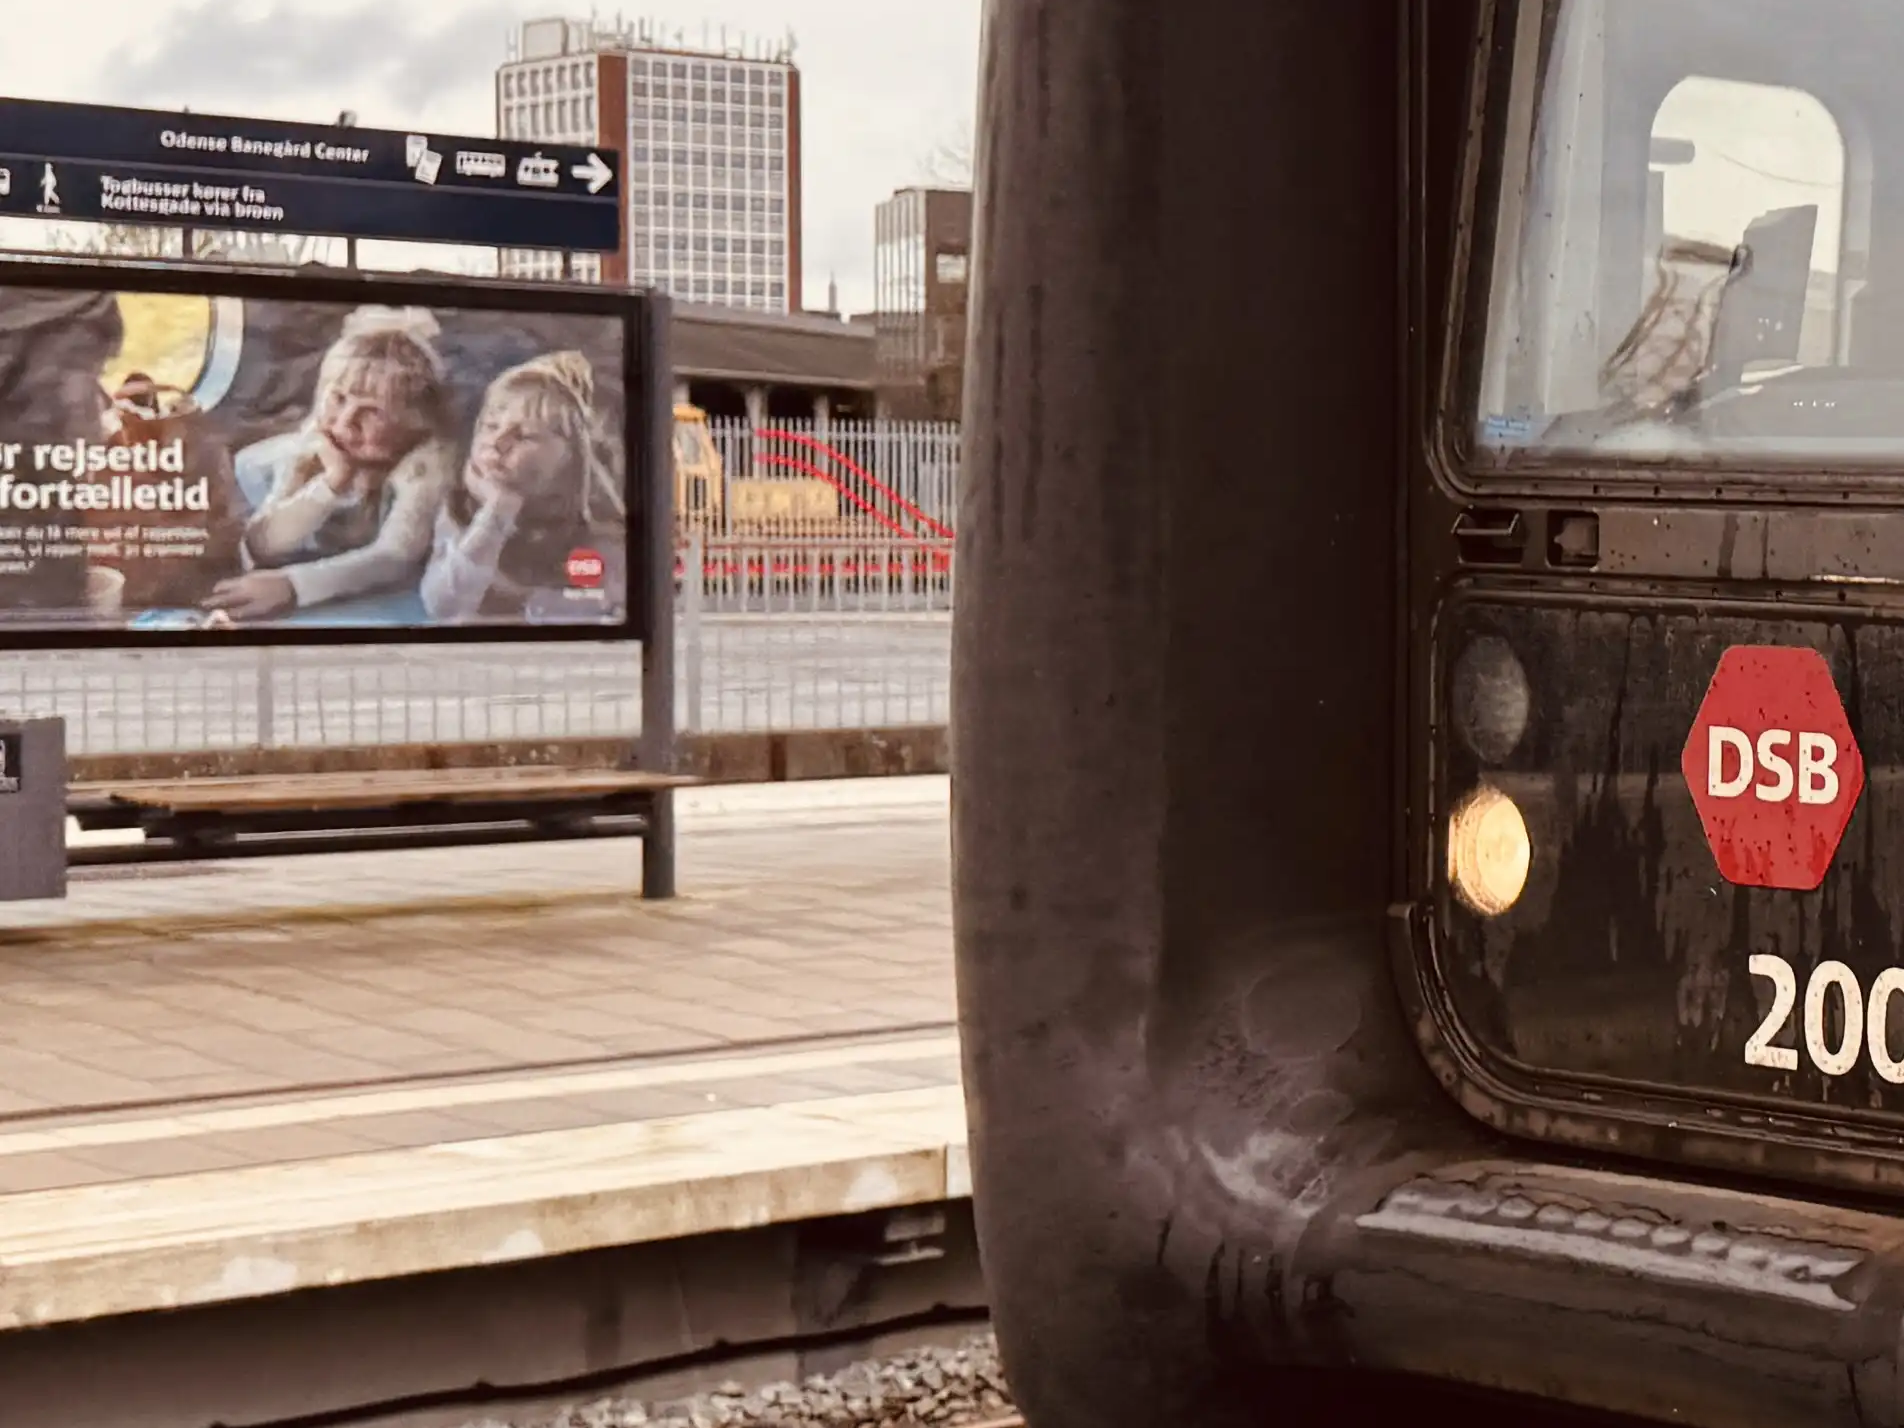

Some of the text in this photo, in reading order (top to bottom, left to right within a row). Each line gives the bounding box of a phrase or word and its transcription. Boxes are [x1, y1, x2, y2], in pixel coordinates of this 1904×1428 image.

[160, 129, 227, 152] Odense
[314, 142, 370, 163] Center
[203, 199, 231, 217] via
[242, 185, 265, 203] fra
[33, 438, 184, 478] rejsetid
[0, 474, 209, 511] fortælletid
[1708, 725, 1839, 804] DSB
